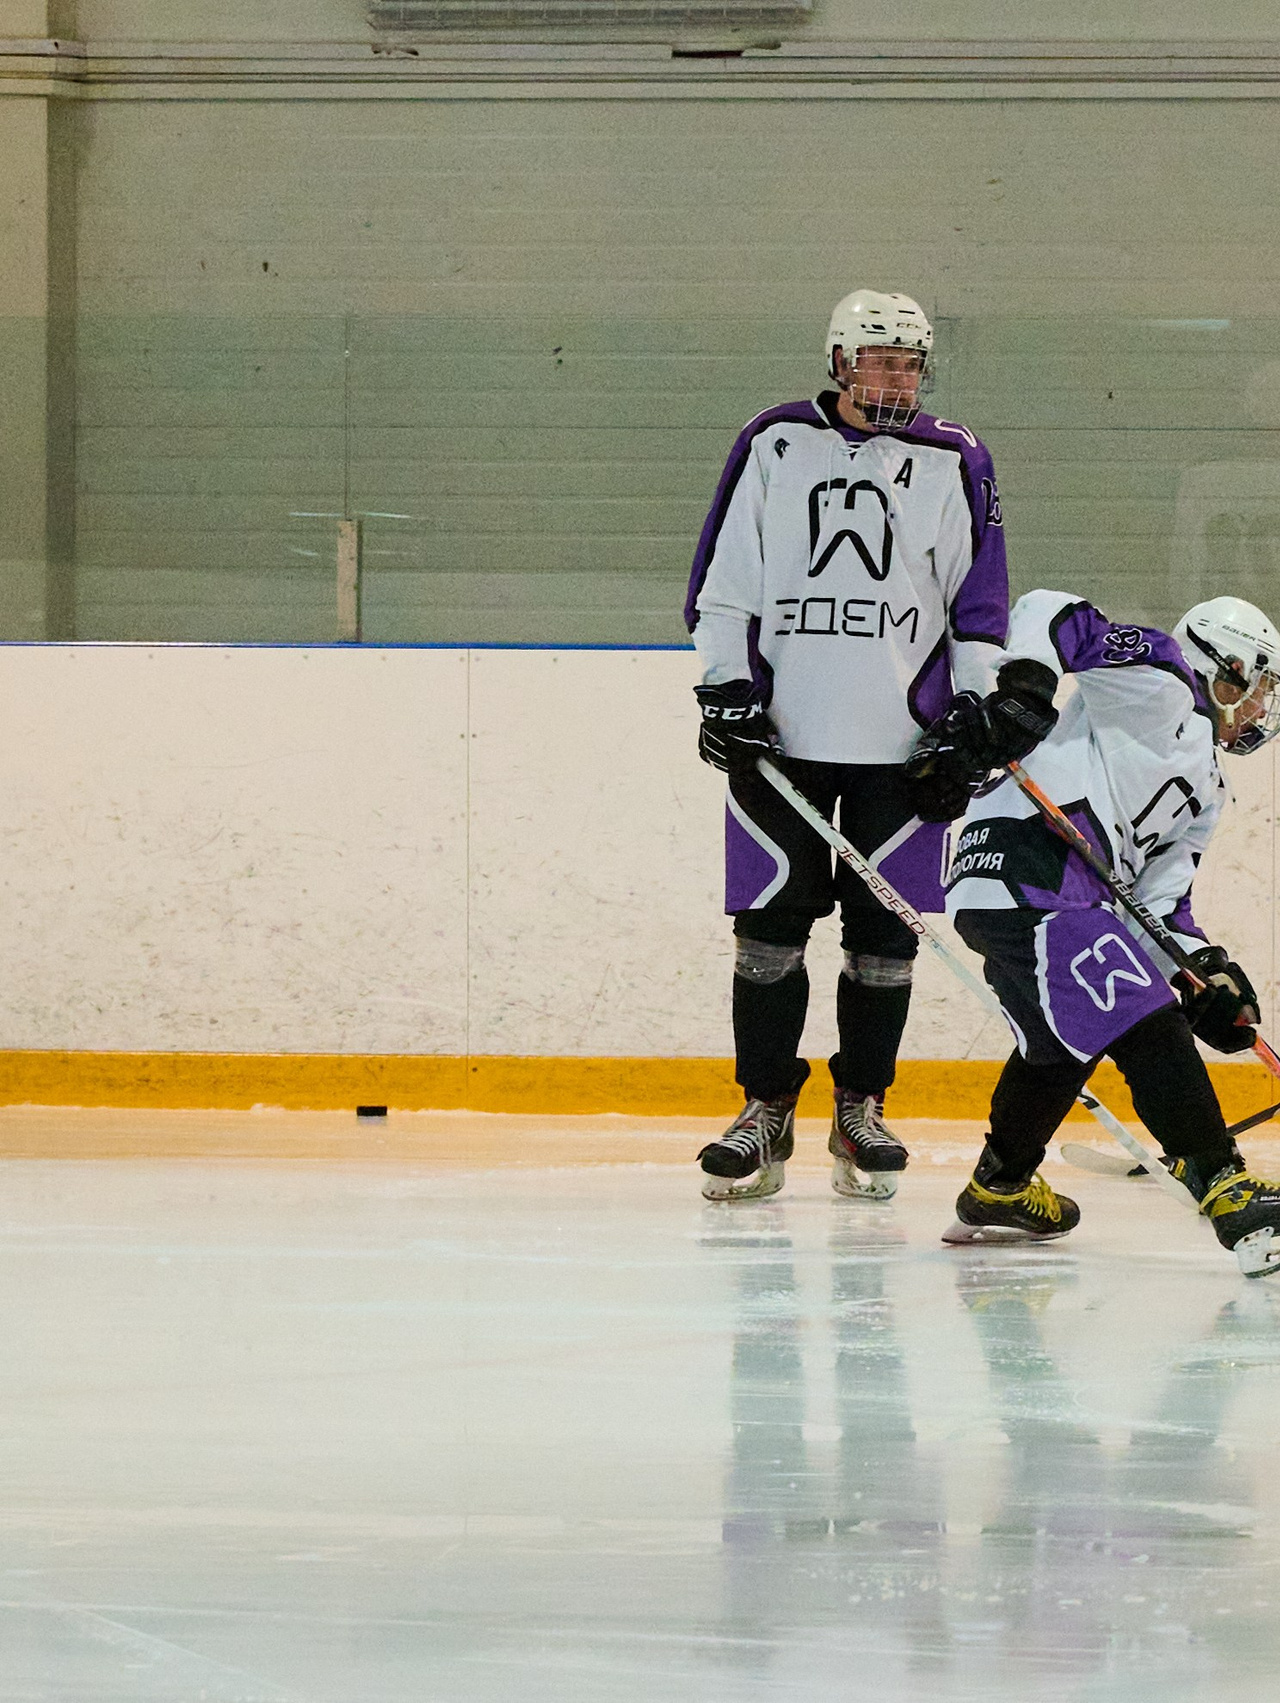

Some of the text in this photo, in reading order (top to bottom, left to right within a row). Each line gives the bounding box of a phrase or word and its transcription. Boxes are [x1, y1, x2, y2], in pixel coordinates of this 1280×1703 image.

[893, 458, 913, 488] A
[775, 597, 919, 643] ЭДЕМ
[703, 700, 763, 720] CCM
[837, 849, 926, 936] JETSPEED
